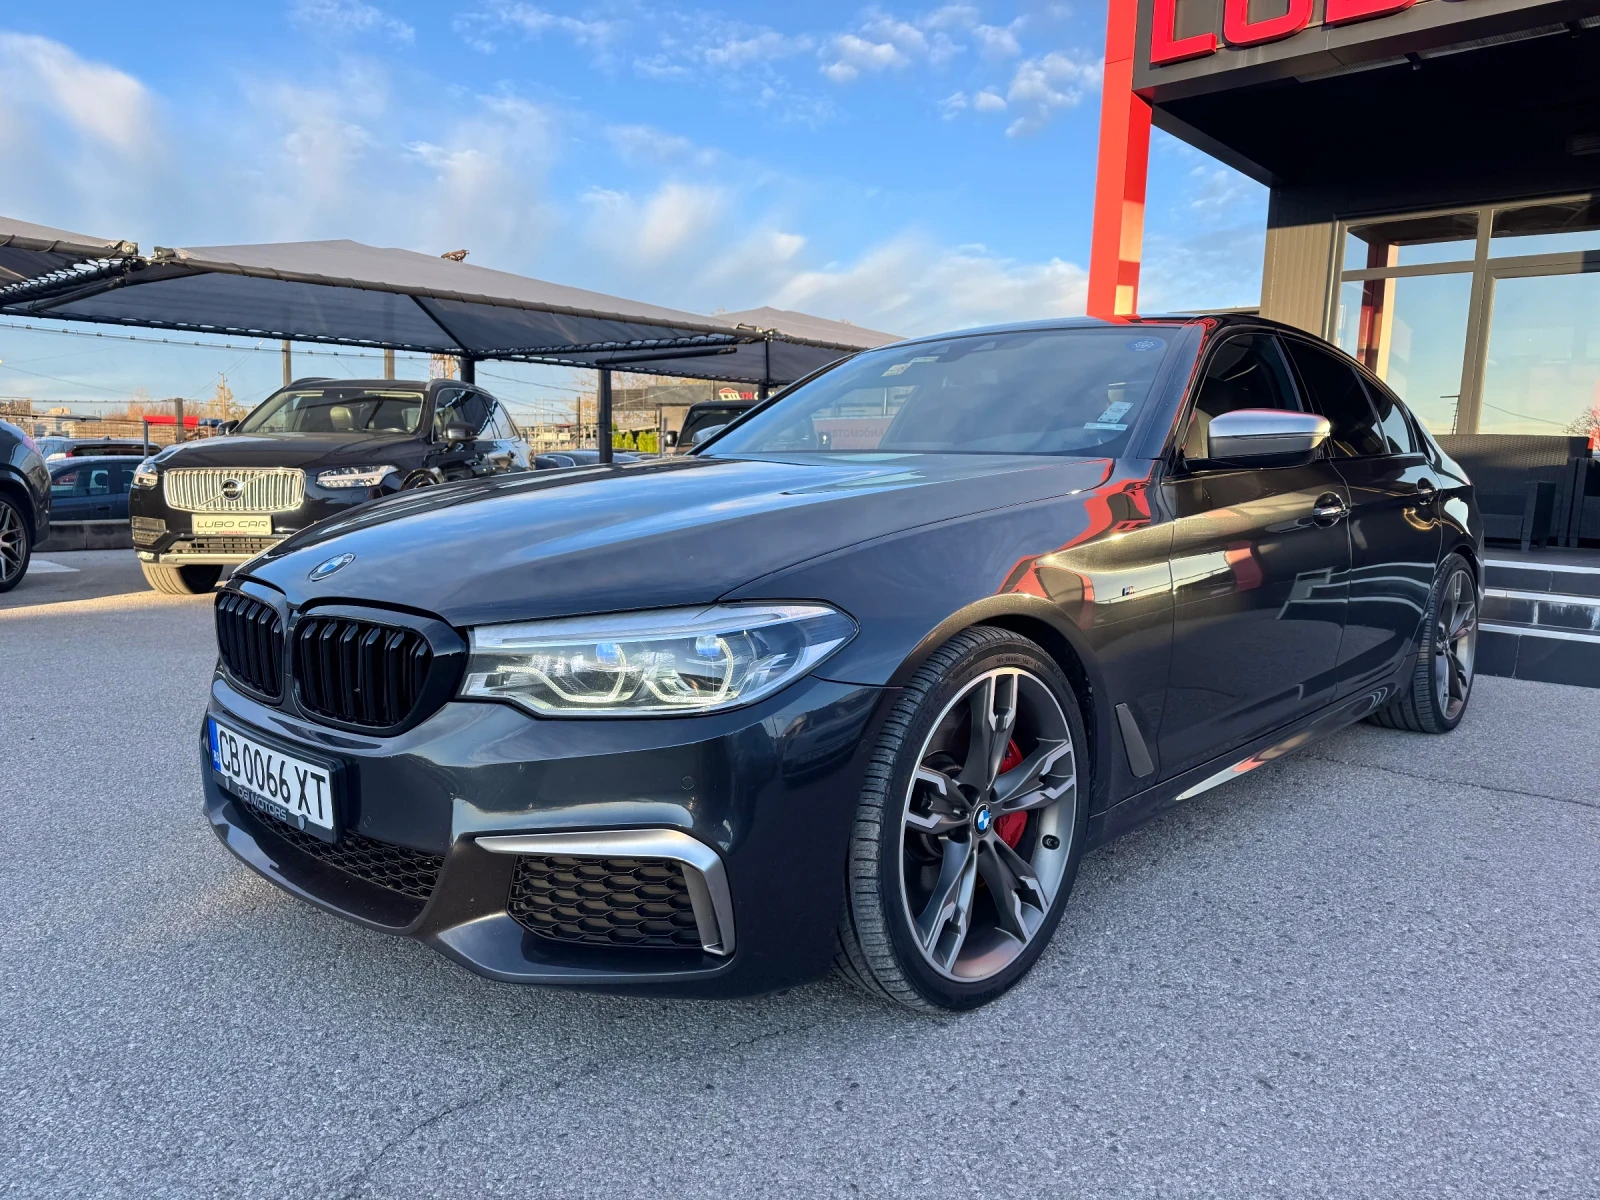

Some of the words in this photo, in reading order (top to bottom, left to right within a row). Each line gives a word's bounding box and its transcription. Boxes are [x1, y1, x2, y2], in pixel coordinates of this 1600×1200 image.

[196, 520, 235, 528] LUBO
[238, 520, 268, 528] CAR
[243, 743, 291, 804] 0066
[250, 792, 287, 821] MOTORS
